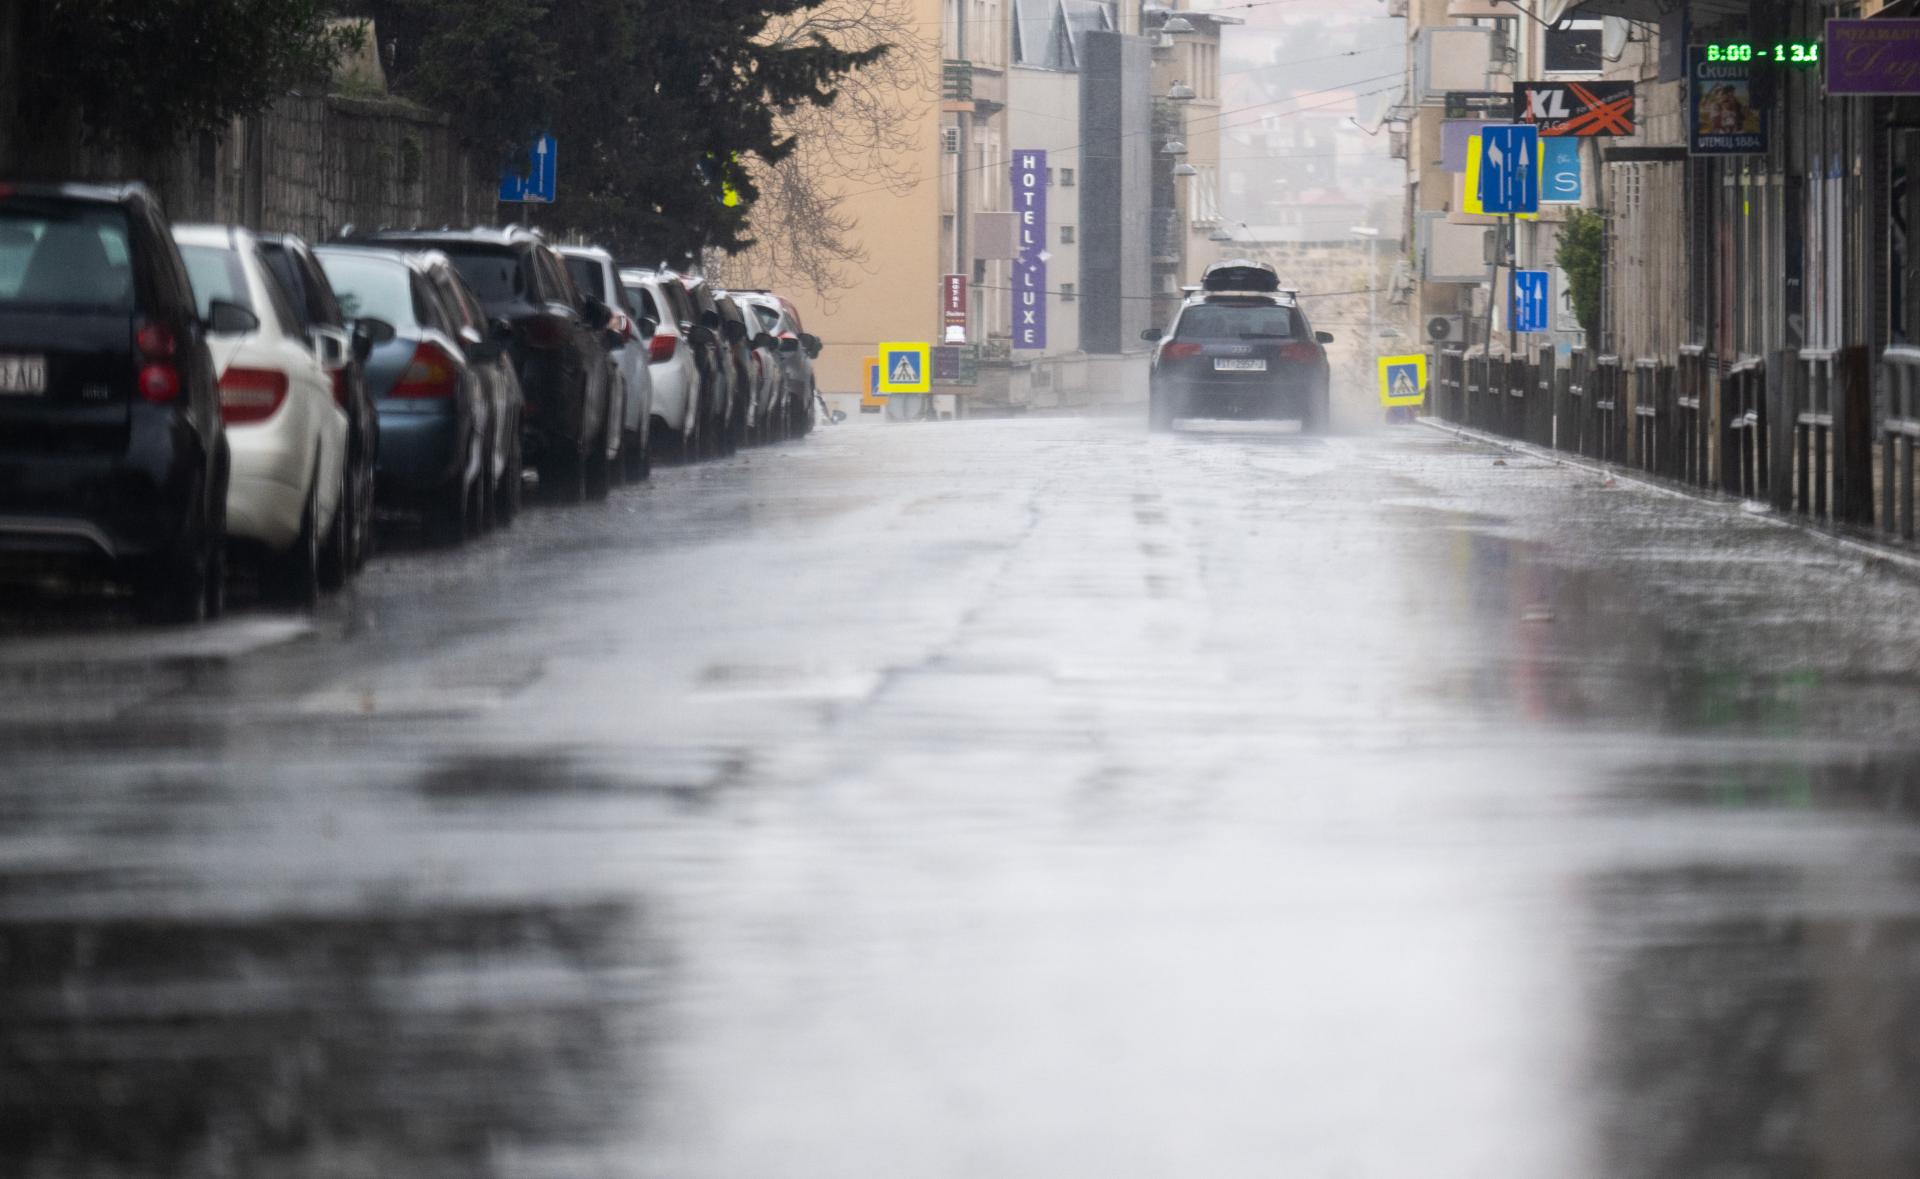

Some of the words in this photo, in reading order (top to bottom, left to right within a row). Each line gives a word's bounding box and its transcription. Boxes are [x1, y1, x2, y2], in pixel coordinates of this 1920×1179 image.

[1707, 44, 1752, 61] 8:00
[1519, 89, 1571, 118] XL
[1023, 155, 1035, 244] HOTEL
[1023, 272, 1035, 344] LUXE
